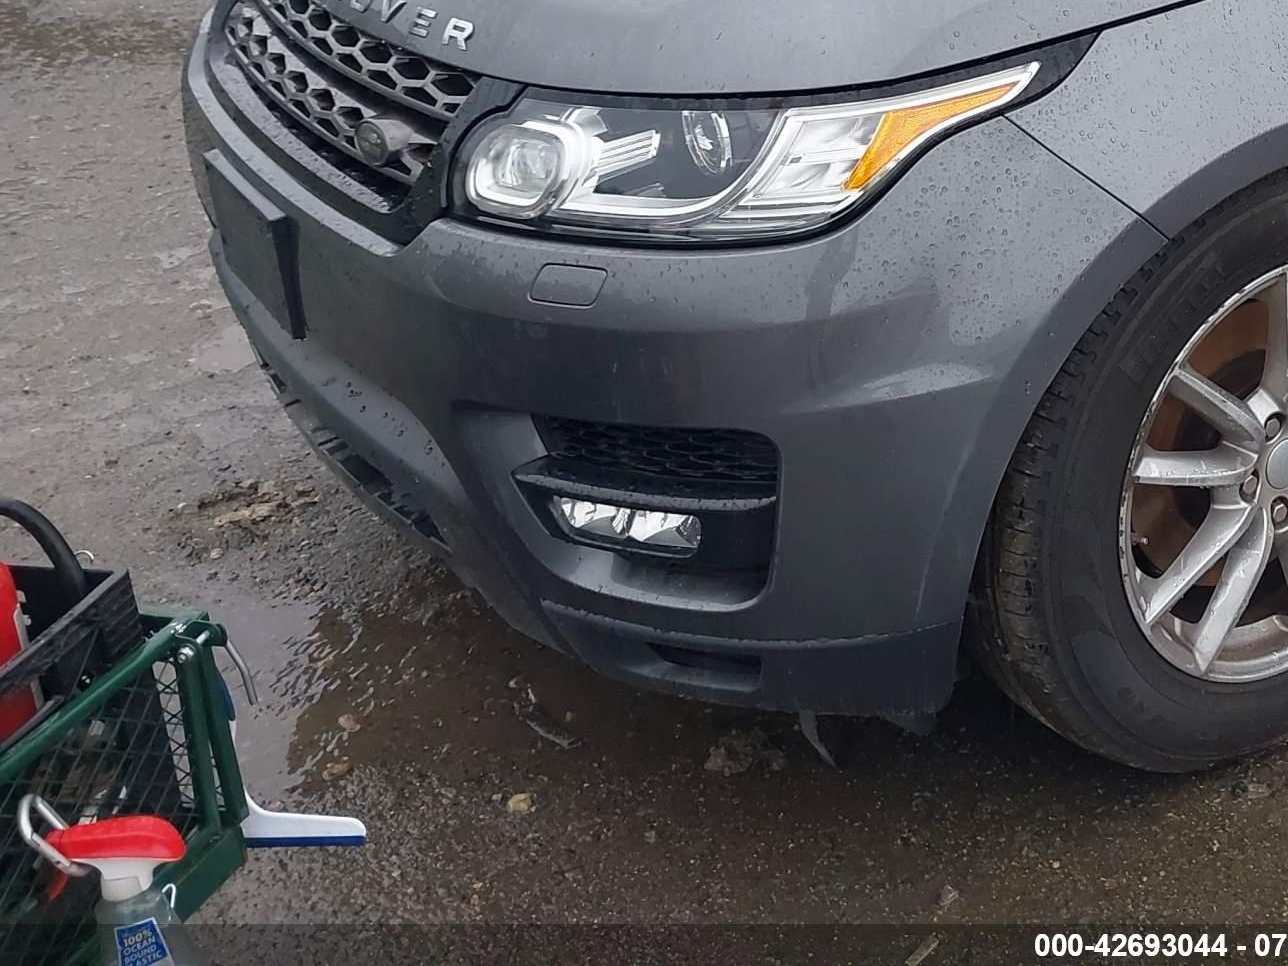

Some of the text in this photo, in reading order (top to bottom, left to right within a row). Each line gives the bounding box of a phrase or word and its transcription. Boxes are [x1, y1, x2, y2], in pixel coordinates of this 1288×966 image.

[123, 929, 152, 947] 100%
[123, 935, 156, 956] OCEAN
[124, 944, 157, 964] BOUND
